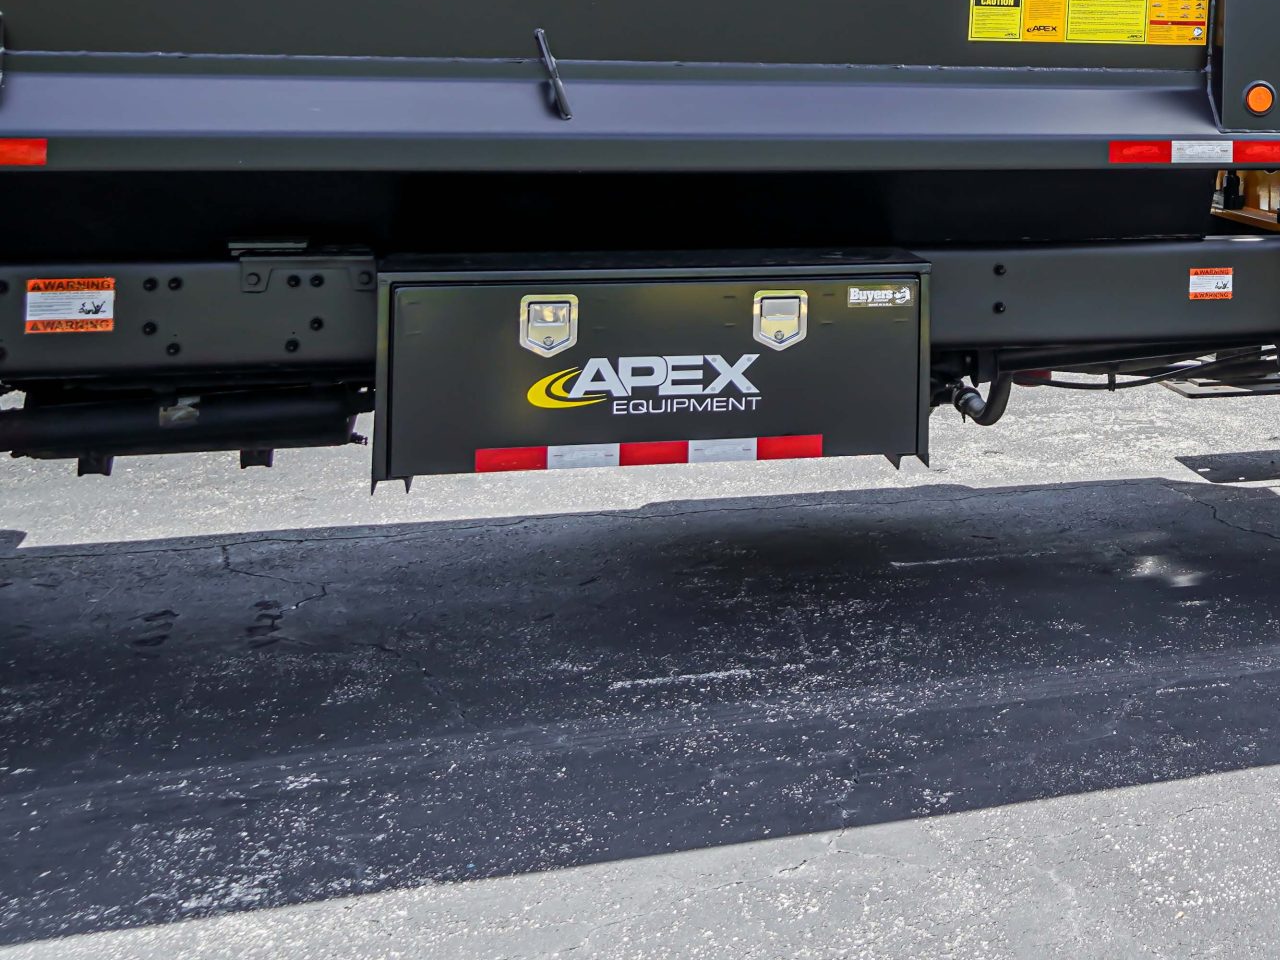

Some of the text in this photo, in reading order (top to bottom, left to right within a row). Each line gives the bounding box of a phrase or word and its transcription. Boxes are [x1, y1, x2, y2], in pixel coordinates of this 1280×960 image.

[44, 280, 111, 290] WARNING
[850, 288, 893, 302] Buyers
[43, 320, 109, 331] WARNING
[567, 354, 760, 399] APEX
[612, 397, 762, 415] EQUIPMENT
